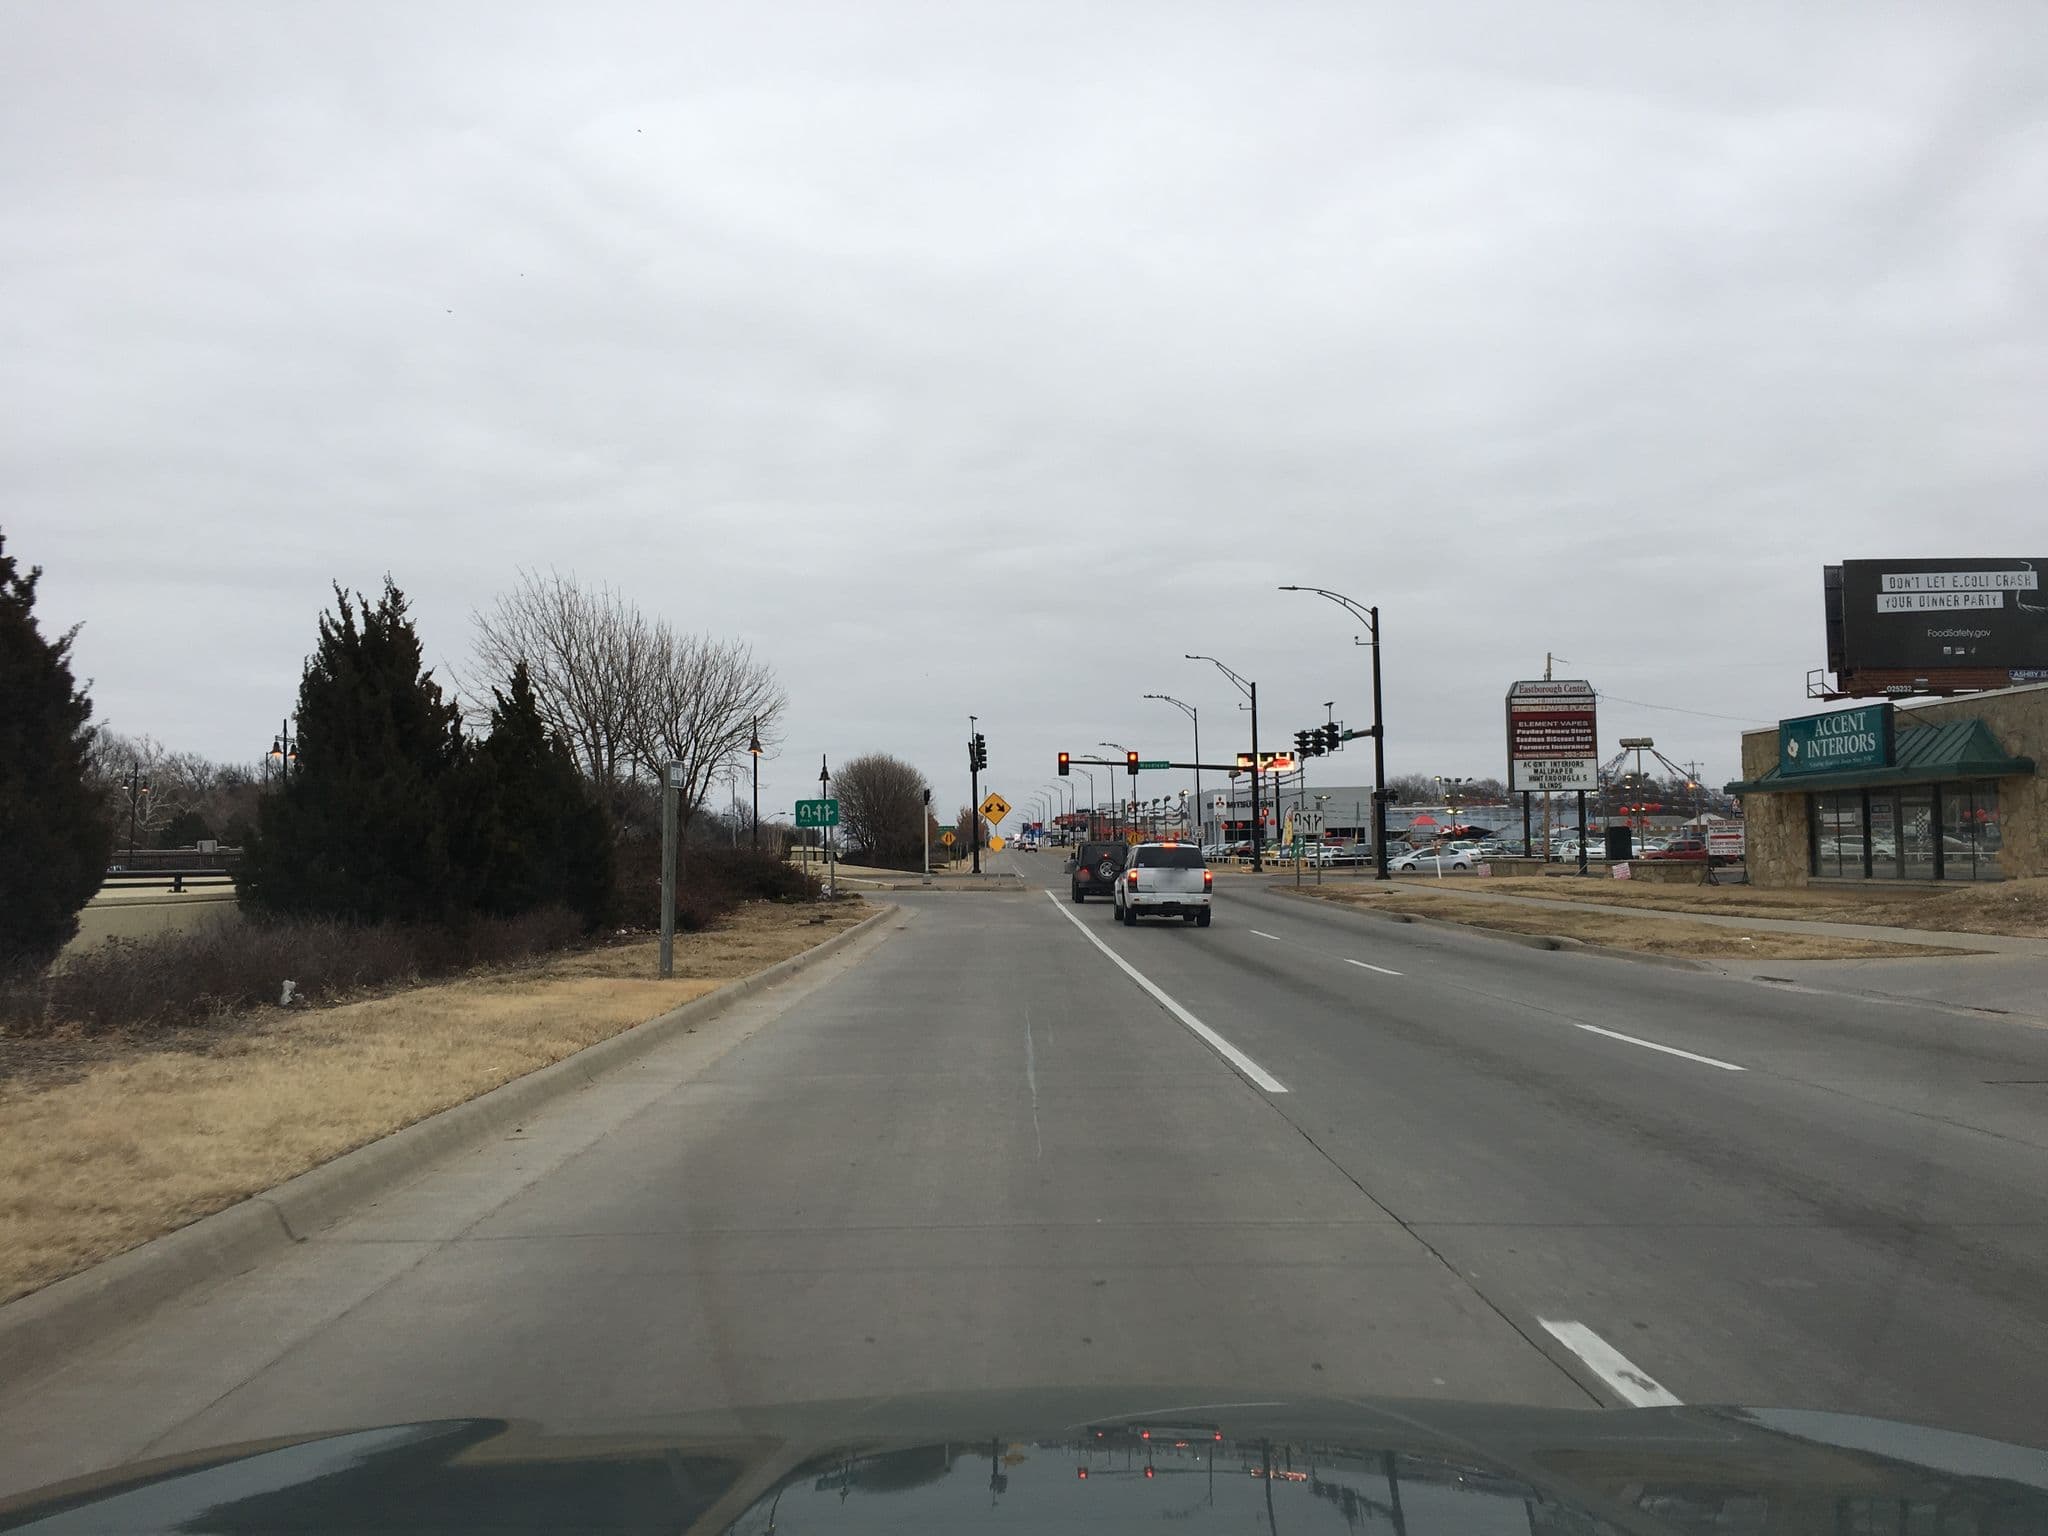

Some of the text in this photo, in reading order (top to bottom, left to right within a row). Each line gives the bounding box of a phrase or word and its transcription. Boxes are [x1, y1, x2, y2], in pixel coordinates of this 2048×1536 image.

[1889, 574, 2032, 589] DON'T LET E.COLI CRASH
[1886, 594, 1997, 609] YOUR DINNER PARTY
[1927, 628, 1991, 638] FoodSafety.gov
[1519, 684, 1587, 694] Eastborough Center
[1815, 711, 1866, 737] ACCENT
[1807, 732, 1876, 759] INTERIORS
[1550, 760, 1585, 768] INTERIORS
